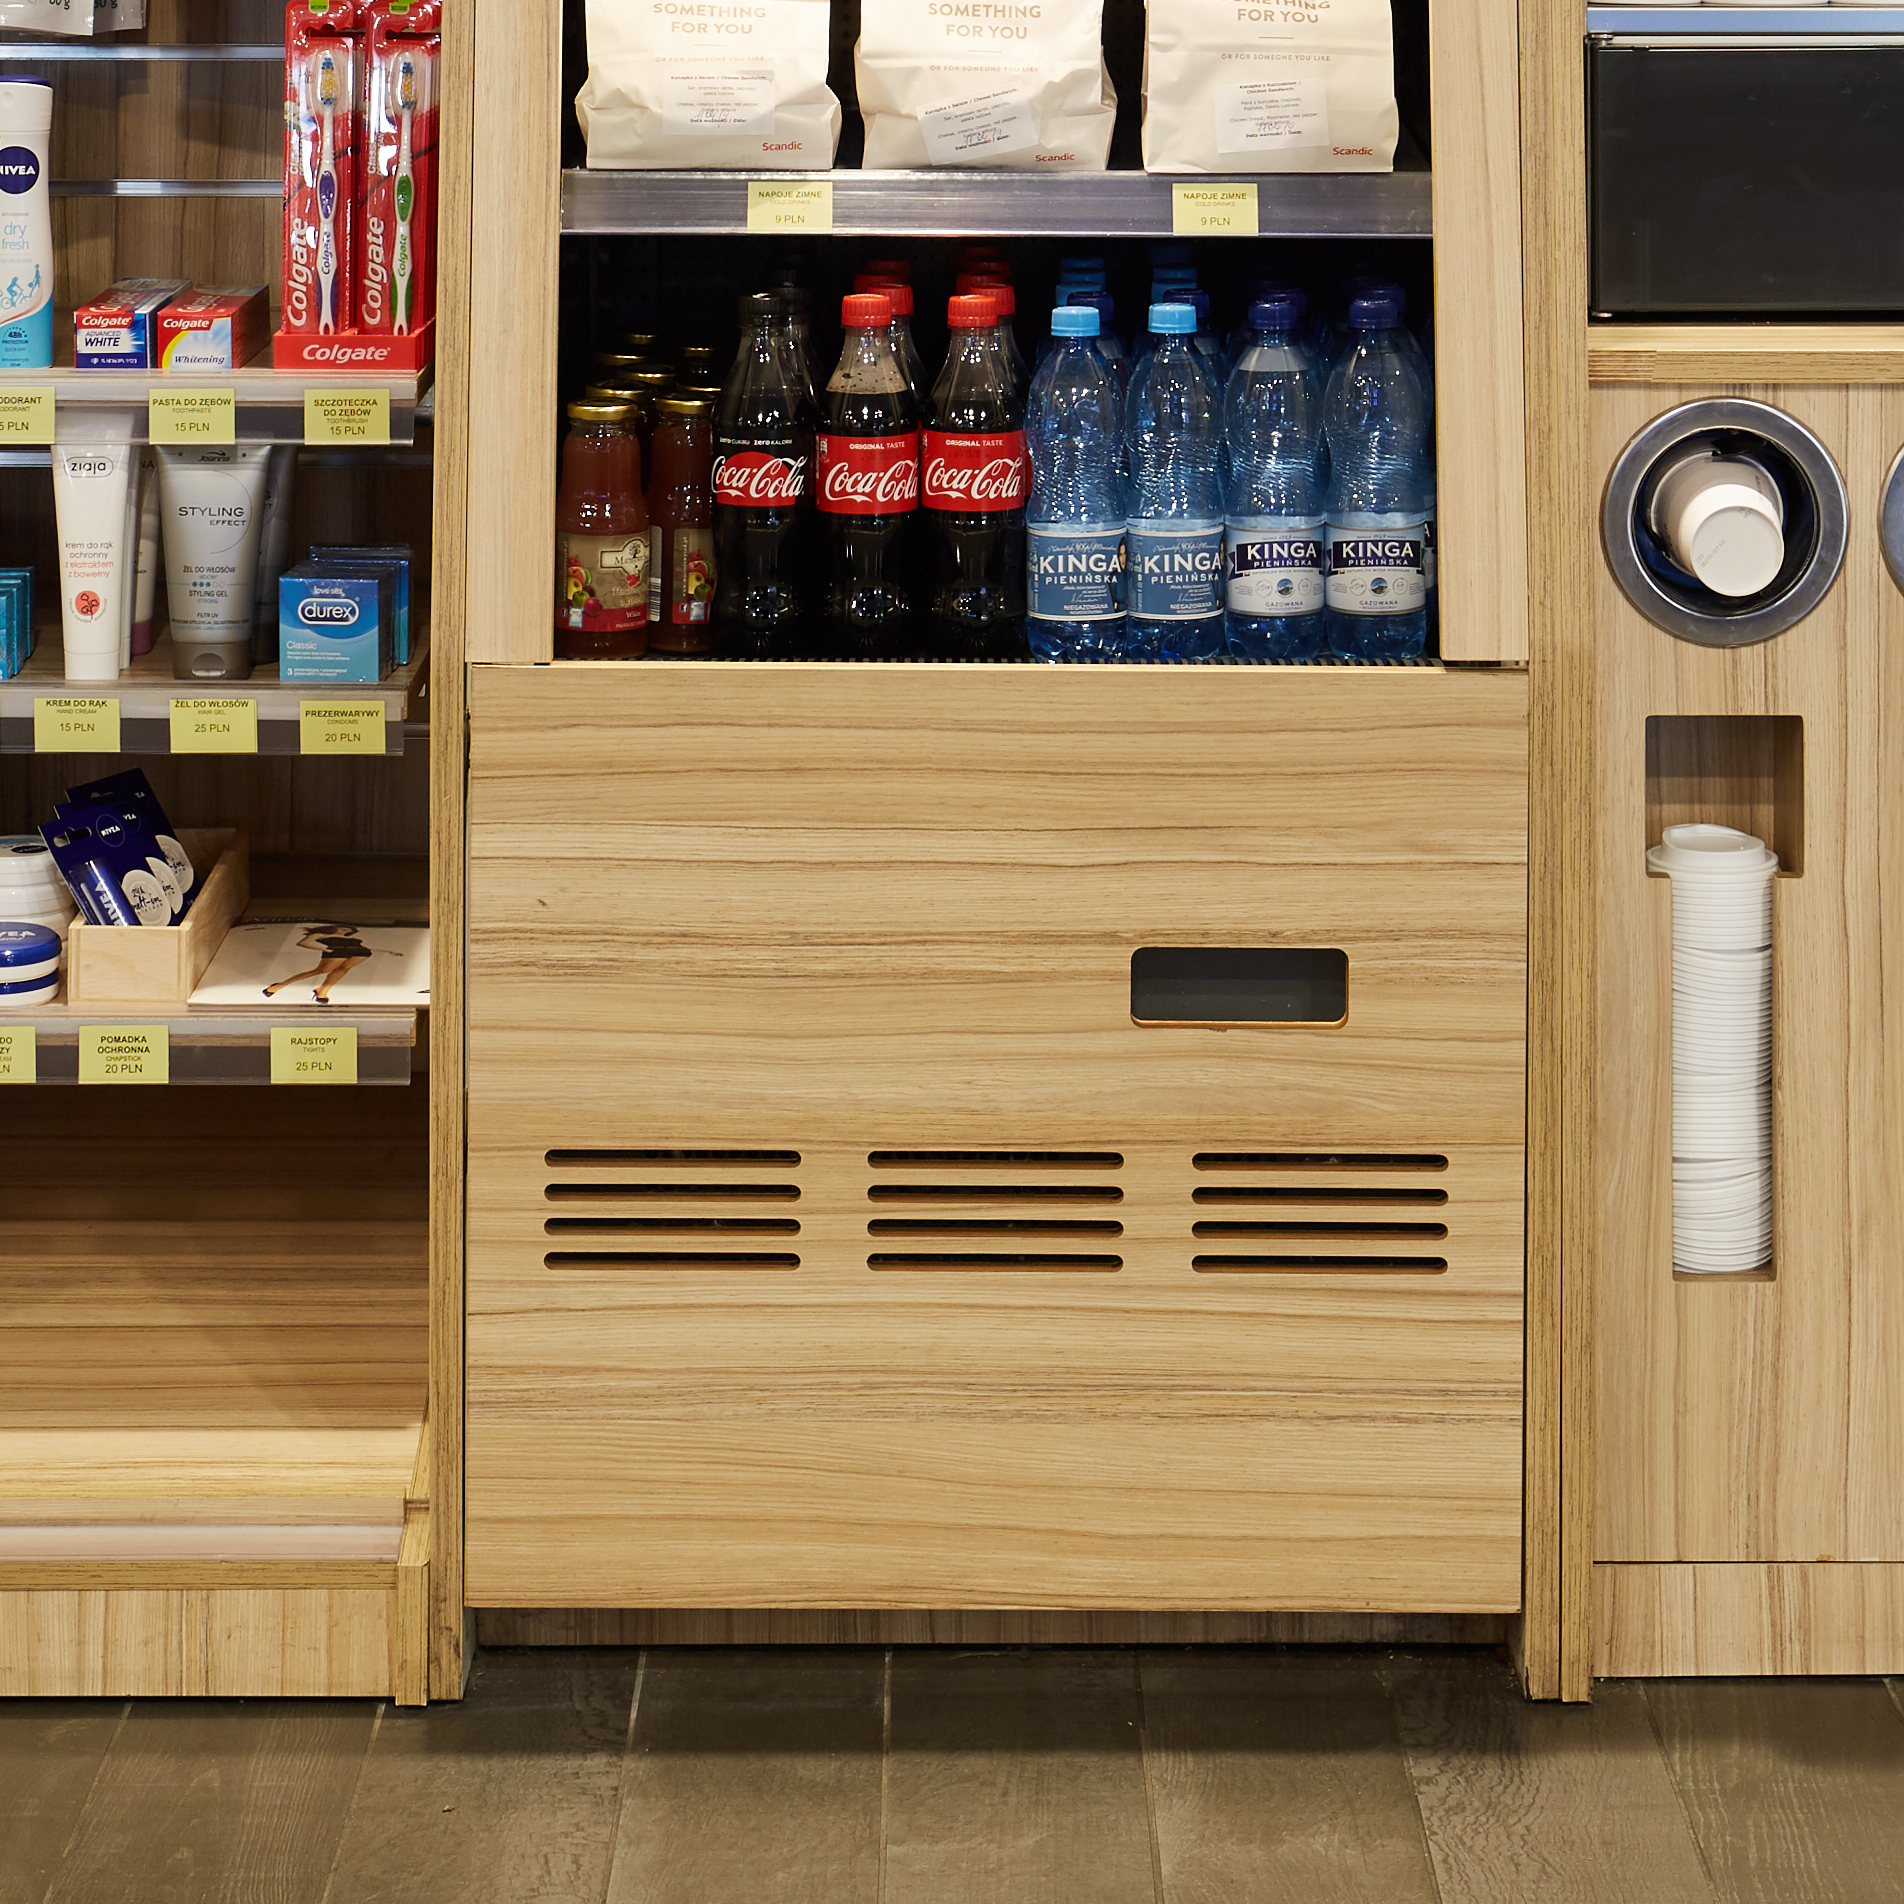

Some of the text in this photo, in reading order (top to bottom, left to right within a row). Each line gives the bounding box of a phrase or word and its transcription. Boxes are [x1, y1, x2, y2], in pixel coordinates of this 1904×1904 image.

[928, 2, 1042, 19] SOMETHING
[945, 24, 1028, 40] FOR YOU
[762, 141, 803, 151] Scandic
[1332, 146, 1373, 156] Scandic
[1035, 152, 1075, 162] Scandic
[1183, 192, 1247, 200] NAPOJE ZIMNE
[1200, 216, 1231, 226] 9 PLN
[3, 221, 27, 239] dry
[1, 238, 29, 250] fresh
[286, 217, 314, 327] Colgate
[361, 216, 389, 326] Colgate
[81, 315, 133, 329] Colgate
[162, 317, 210, 331] Colgate
[84, 336, 120, 348] WHITE
[173, 354, 226, 366] Whitening
[301, 344, 391, 364] Colgate
[152, 397, 232, 408] PASTA DO ZĘBÓW
[7, 420, 29, 431] PLN
[174, 422, 210, 432] 15 PLN
[70, 460, 107, 475] ziaja
[710, 455, 809, 499] Coca-Cola
[925, 456, 1023, 500] Coca-Cola
[178, 506, 245, 518] STYLING
[209, 519, 247, 527] EFFECT
[1247, 542, 1318, 560] KINGA
[1341, 541, 1414, 559] KINGA
[1038, 553, 1122, 574] KINGA
[1143, 551, 1222, 573] KINGA
[1347, 557, 1409, 568] PIENIŃSKA
[303, 601, 354, 620] durex
[305, 709, 380, 718] PREZERWARYWY
[324, 732, 362, 743] 20 PLN
